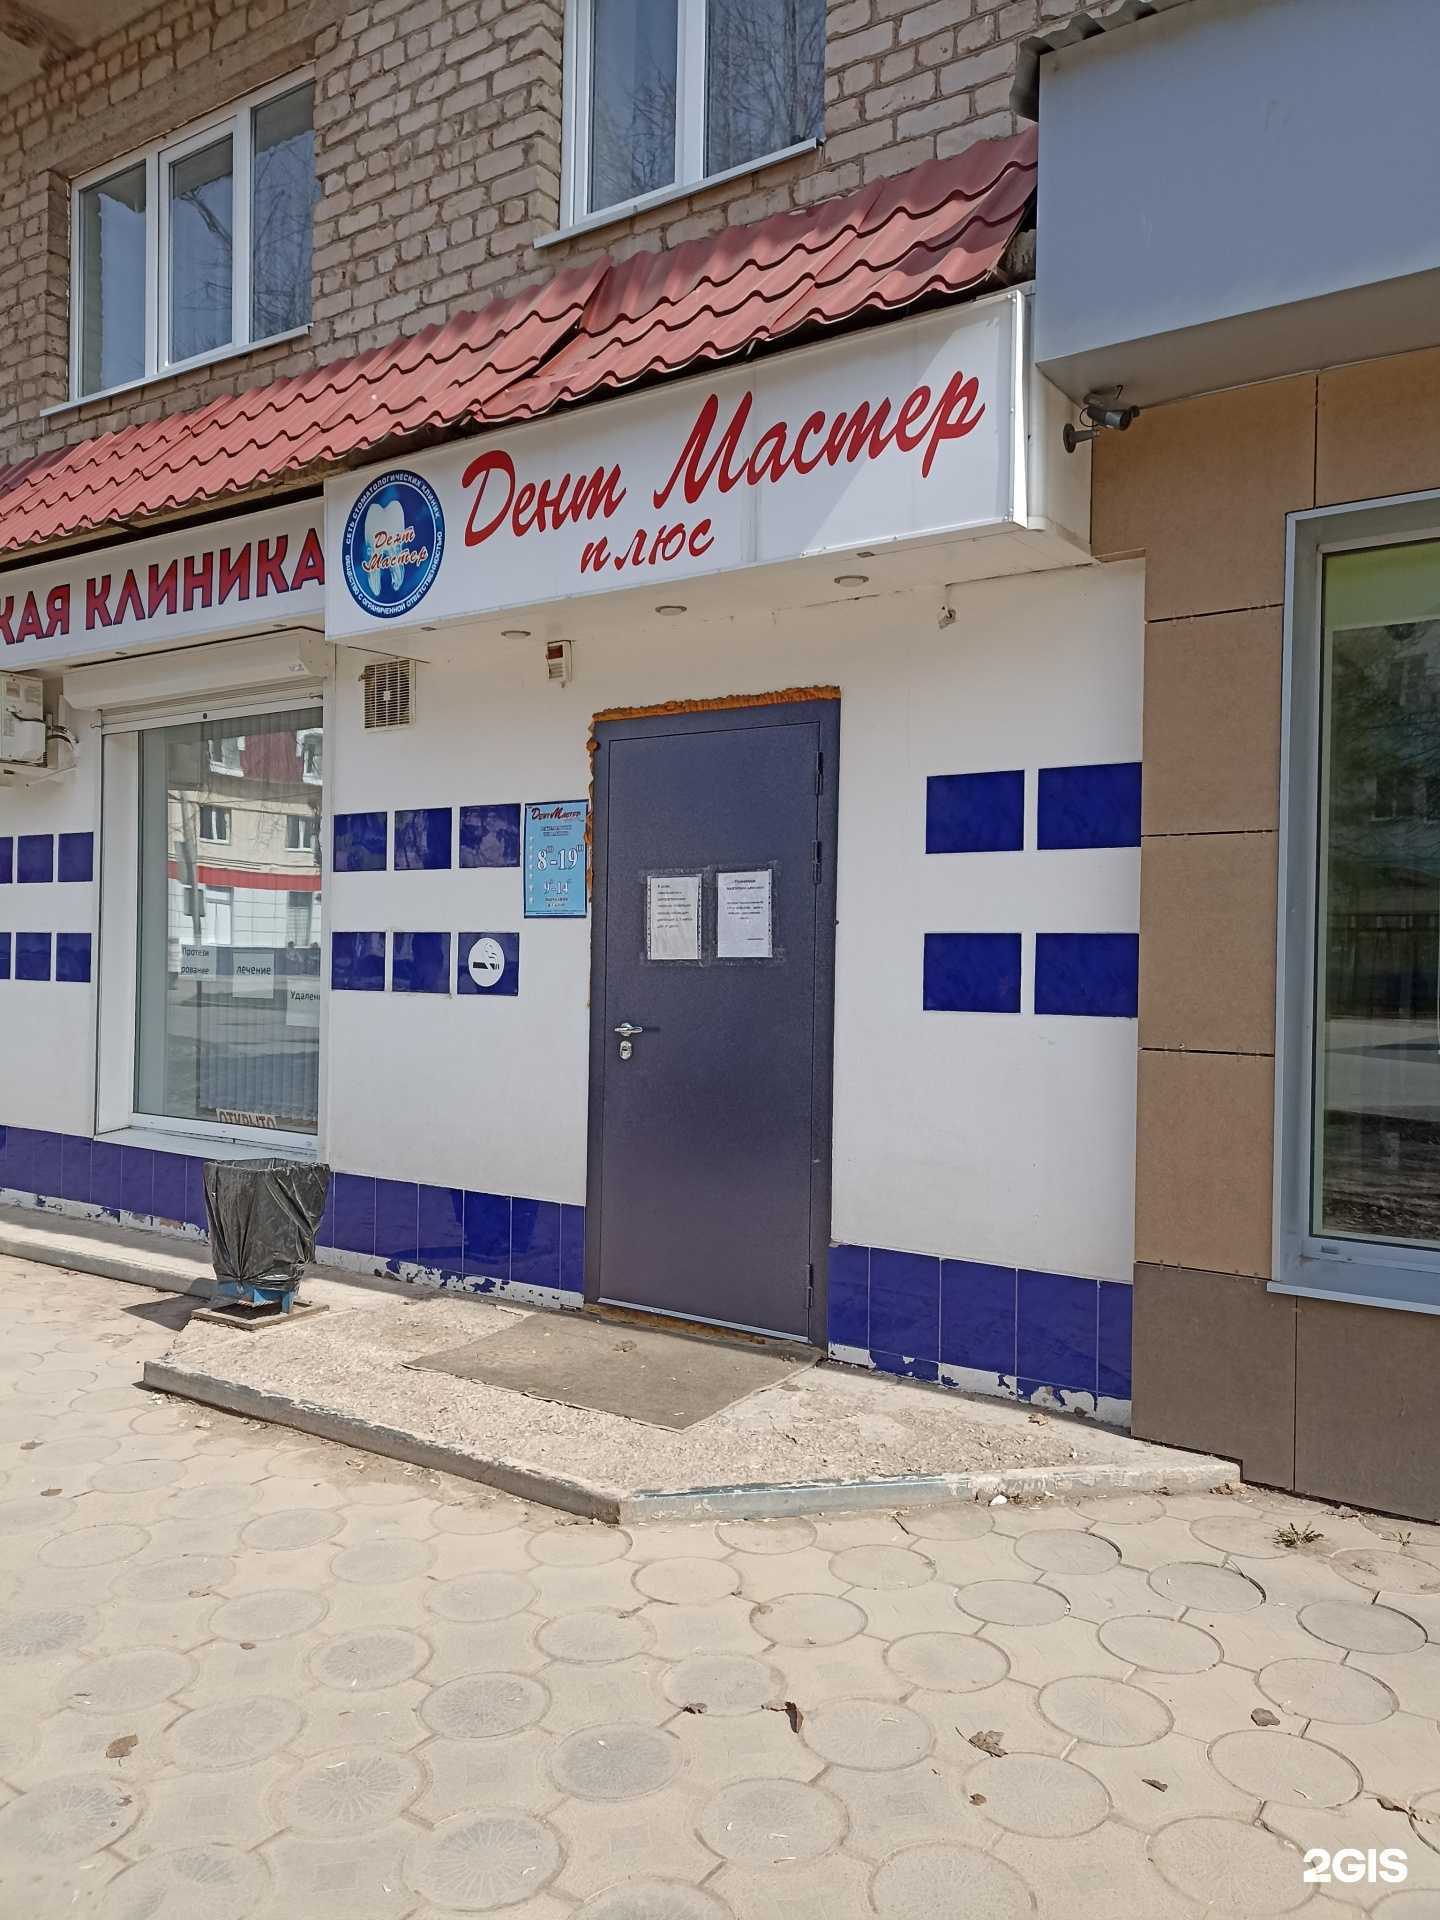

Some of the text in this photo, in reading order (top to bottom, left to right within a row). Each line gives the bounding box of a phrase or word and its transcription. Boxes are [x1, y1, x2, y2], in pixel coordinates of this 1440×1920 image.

[462, 371, 986, 547] Дент Мастер
[422, 484, 440, 519] КЛИНИК
[580, 518, 715, 574] плюс
[86, 527, 325, 630] КЛИНИКА
[236, 965, 271, 975] лечение
